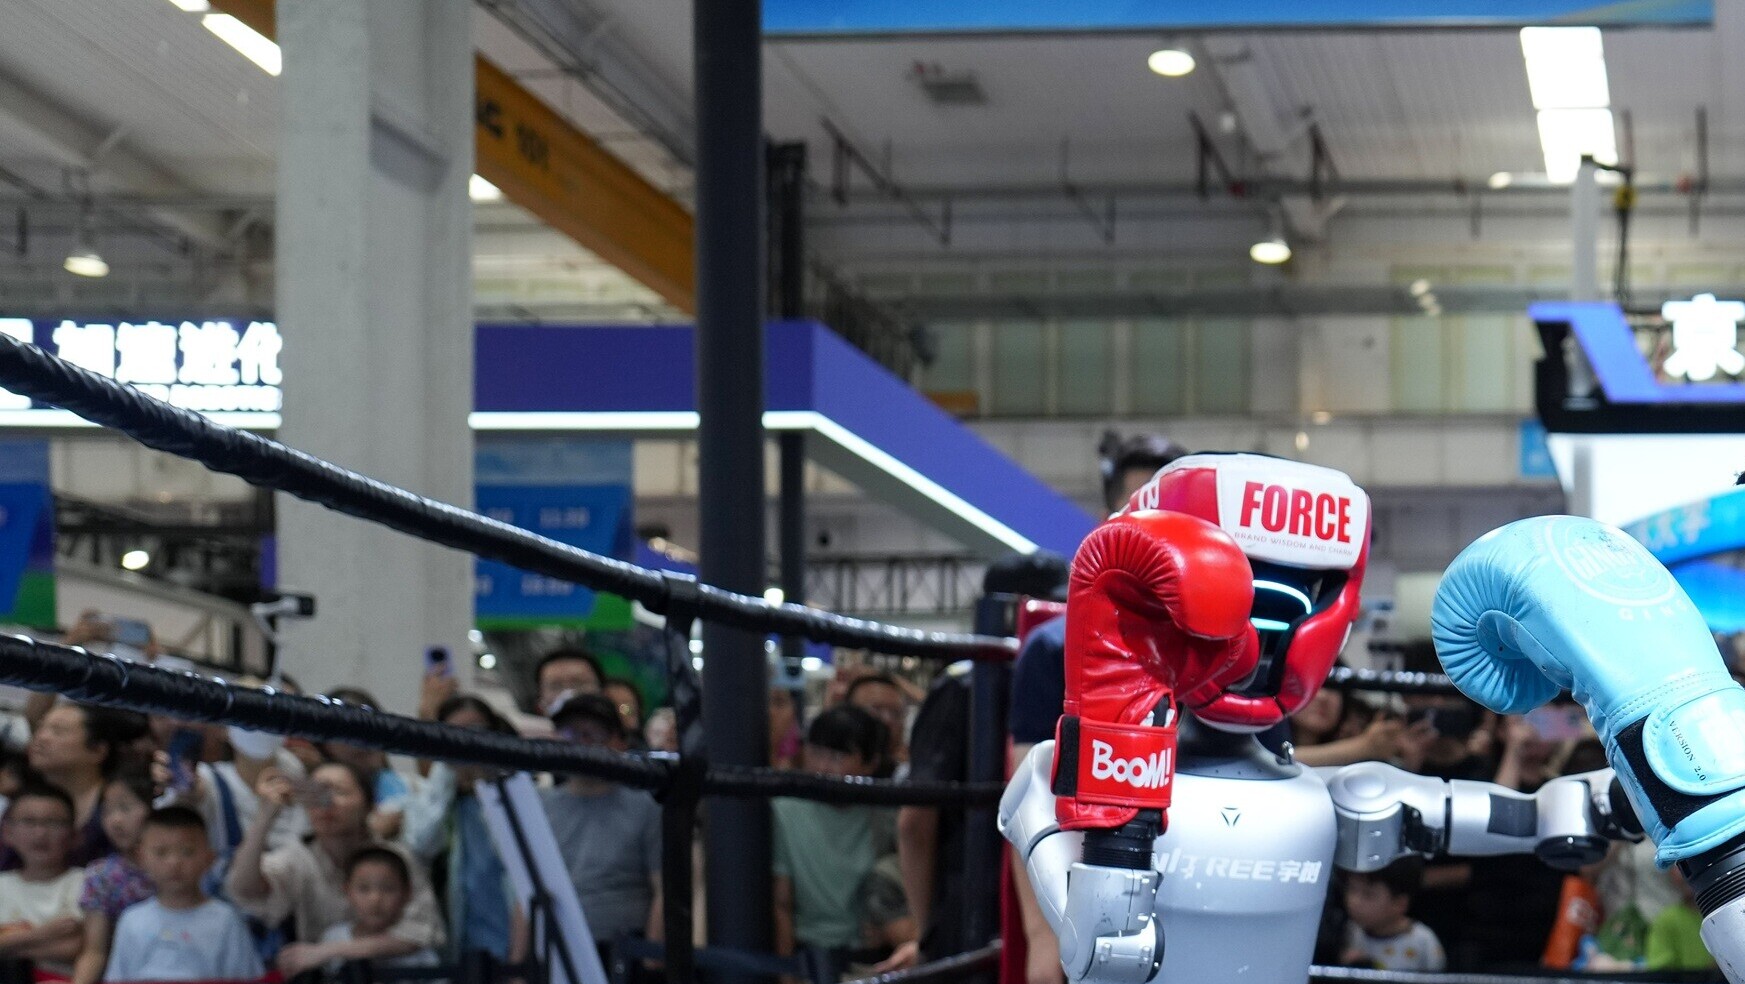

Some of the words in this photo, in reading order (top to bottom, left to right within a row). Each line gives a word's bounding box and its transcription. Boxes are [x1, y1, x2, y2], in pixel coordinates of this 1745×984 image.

[1235, 532, 1268, 544] BRAND
[1271, 537, 1307, 550] WISDOM
[1309, 543, 1327, 552] AND
[1240, 481, 1352, 543] FORCE
[1668, 720, 1696, 762] VERSION
[1693, 765, 1707, 782] 2.0
